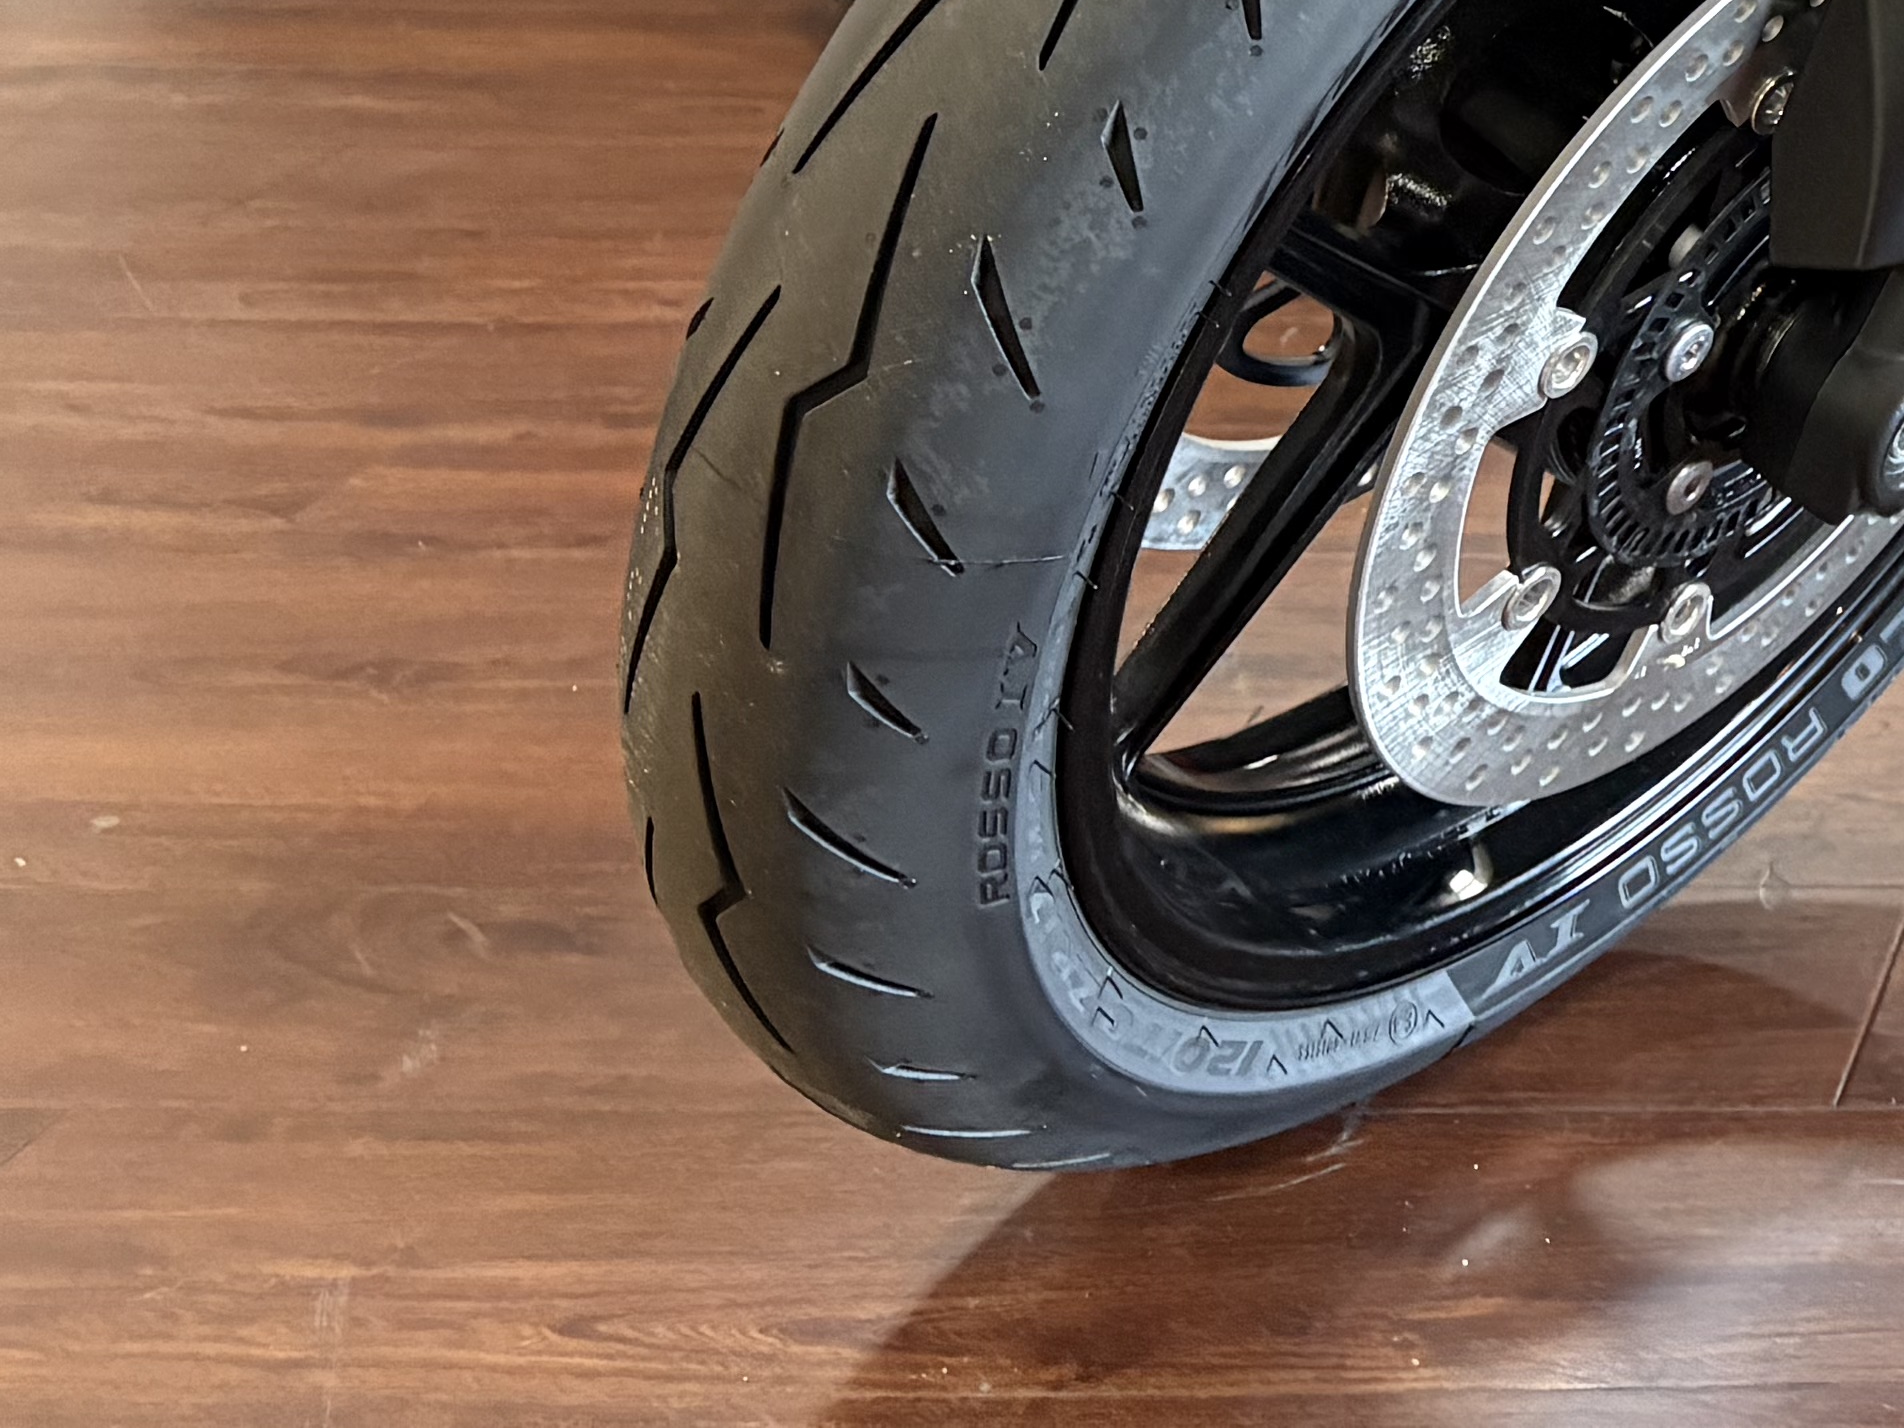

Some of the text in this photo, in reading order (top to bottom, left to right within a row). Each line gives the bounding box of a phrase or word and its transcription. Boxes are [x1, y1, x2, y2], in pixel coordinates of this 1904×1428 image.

[974, 621, 1038, 907] ROSSO IV
[1617, 707, 1829, 911] ROSSO
[1480, 898, 1592, 1001] IV
